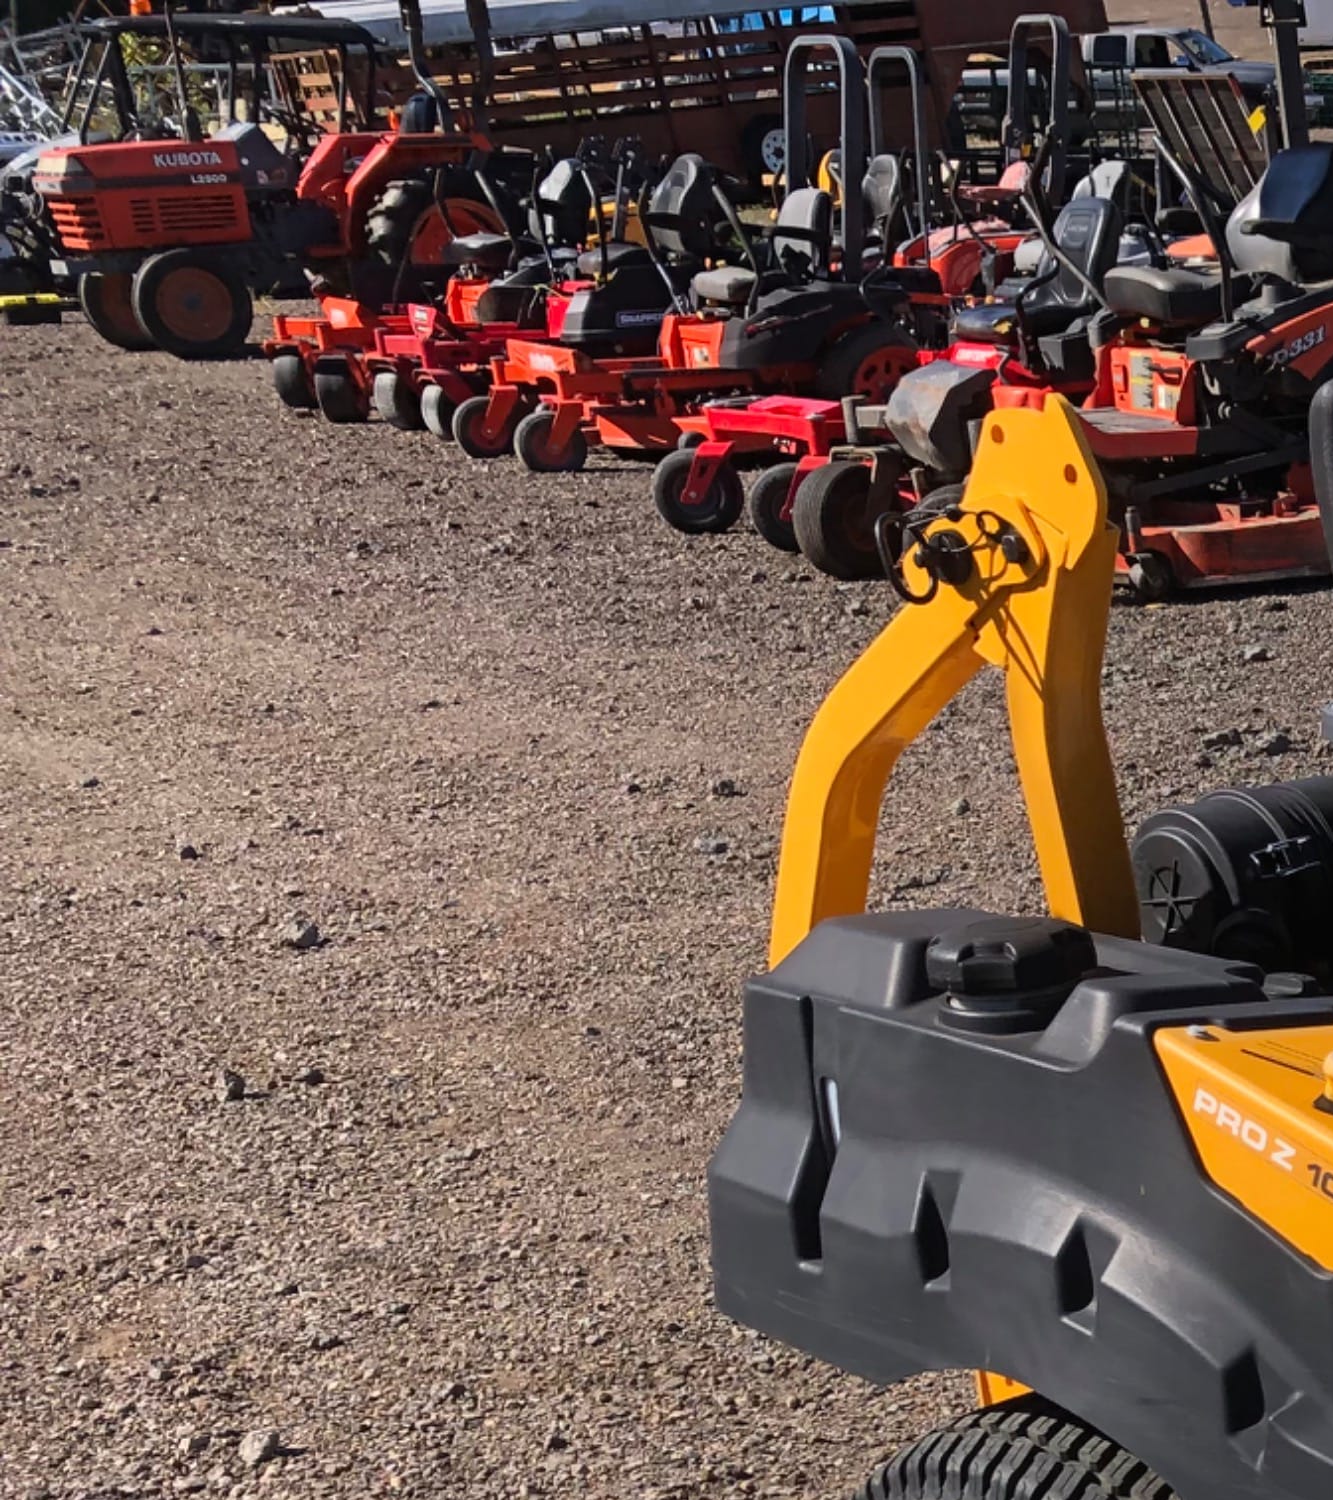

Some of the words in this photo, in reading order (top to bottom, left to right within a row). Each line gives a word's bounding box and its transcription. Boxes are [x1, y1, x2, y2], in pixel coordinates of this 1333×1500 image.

[153, 151, 222, 168] KUBOTA
[1193, 1087, 1269, 1153] PRO
[1270, 1137, 1297, 1172] Z
